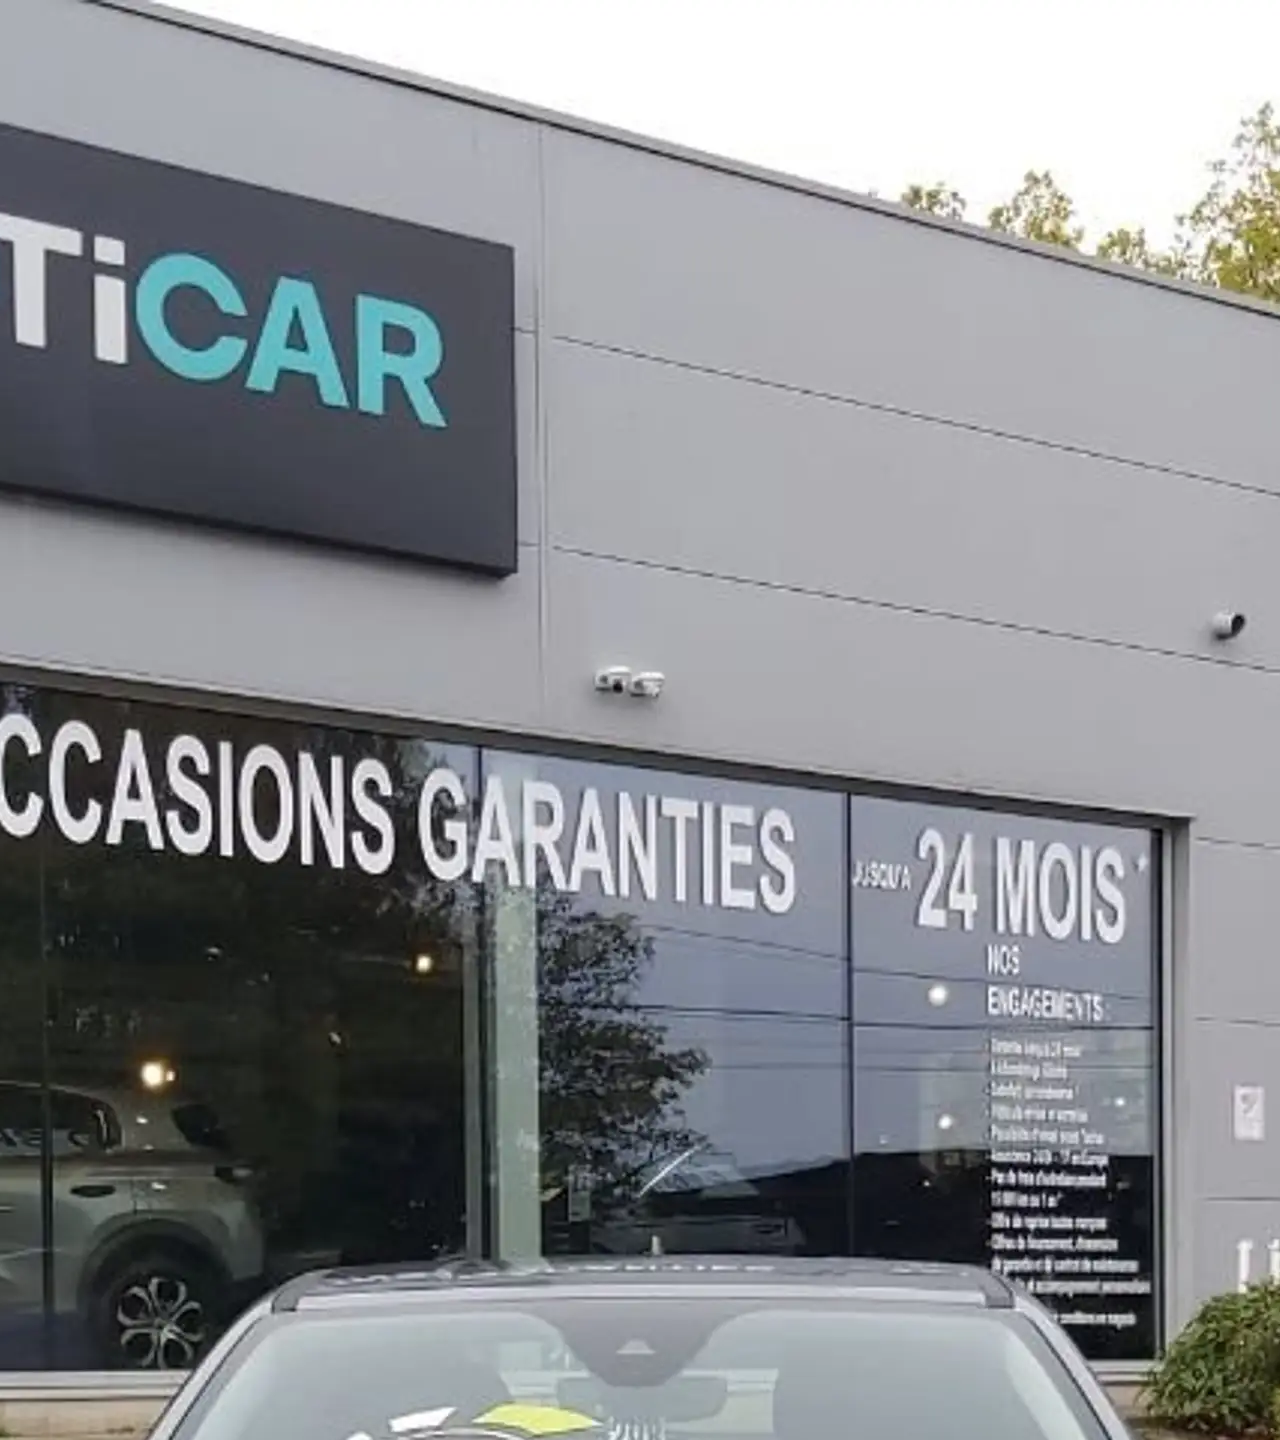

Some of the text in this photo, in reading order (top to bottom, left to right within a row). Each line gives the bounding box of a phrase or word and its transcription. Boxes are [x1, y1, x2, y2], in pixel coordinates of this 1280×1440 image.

[418, 766, 796, 915] GARANTIES
[918, 828, 978, 932] 24
[987, 945, 1020, 976] NOS
[987, 986, 1103, 1022] ENGAGEMENTS
